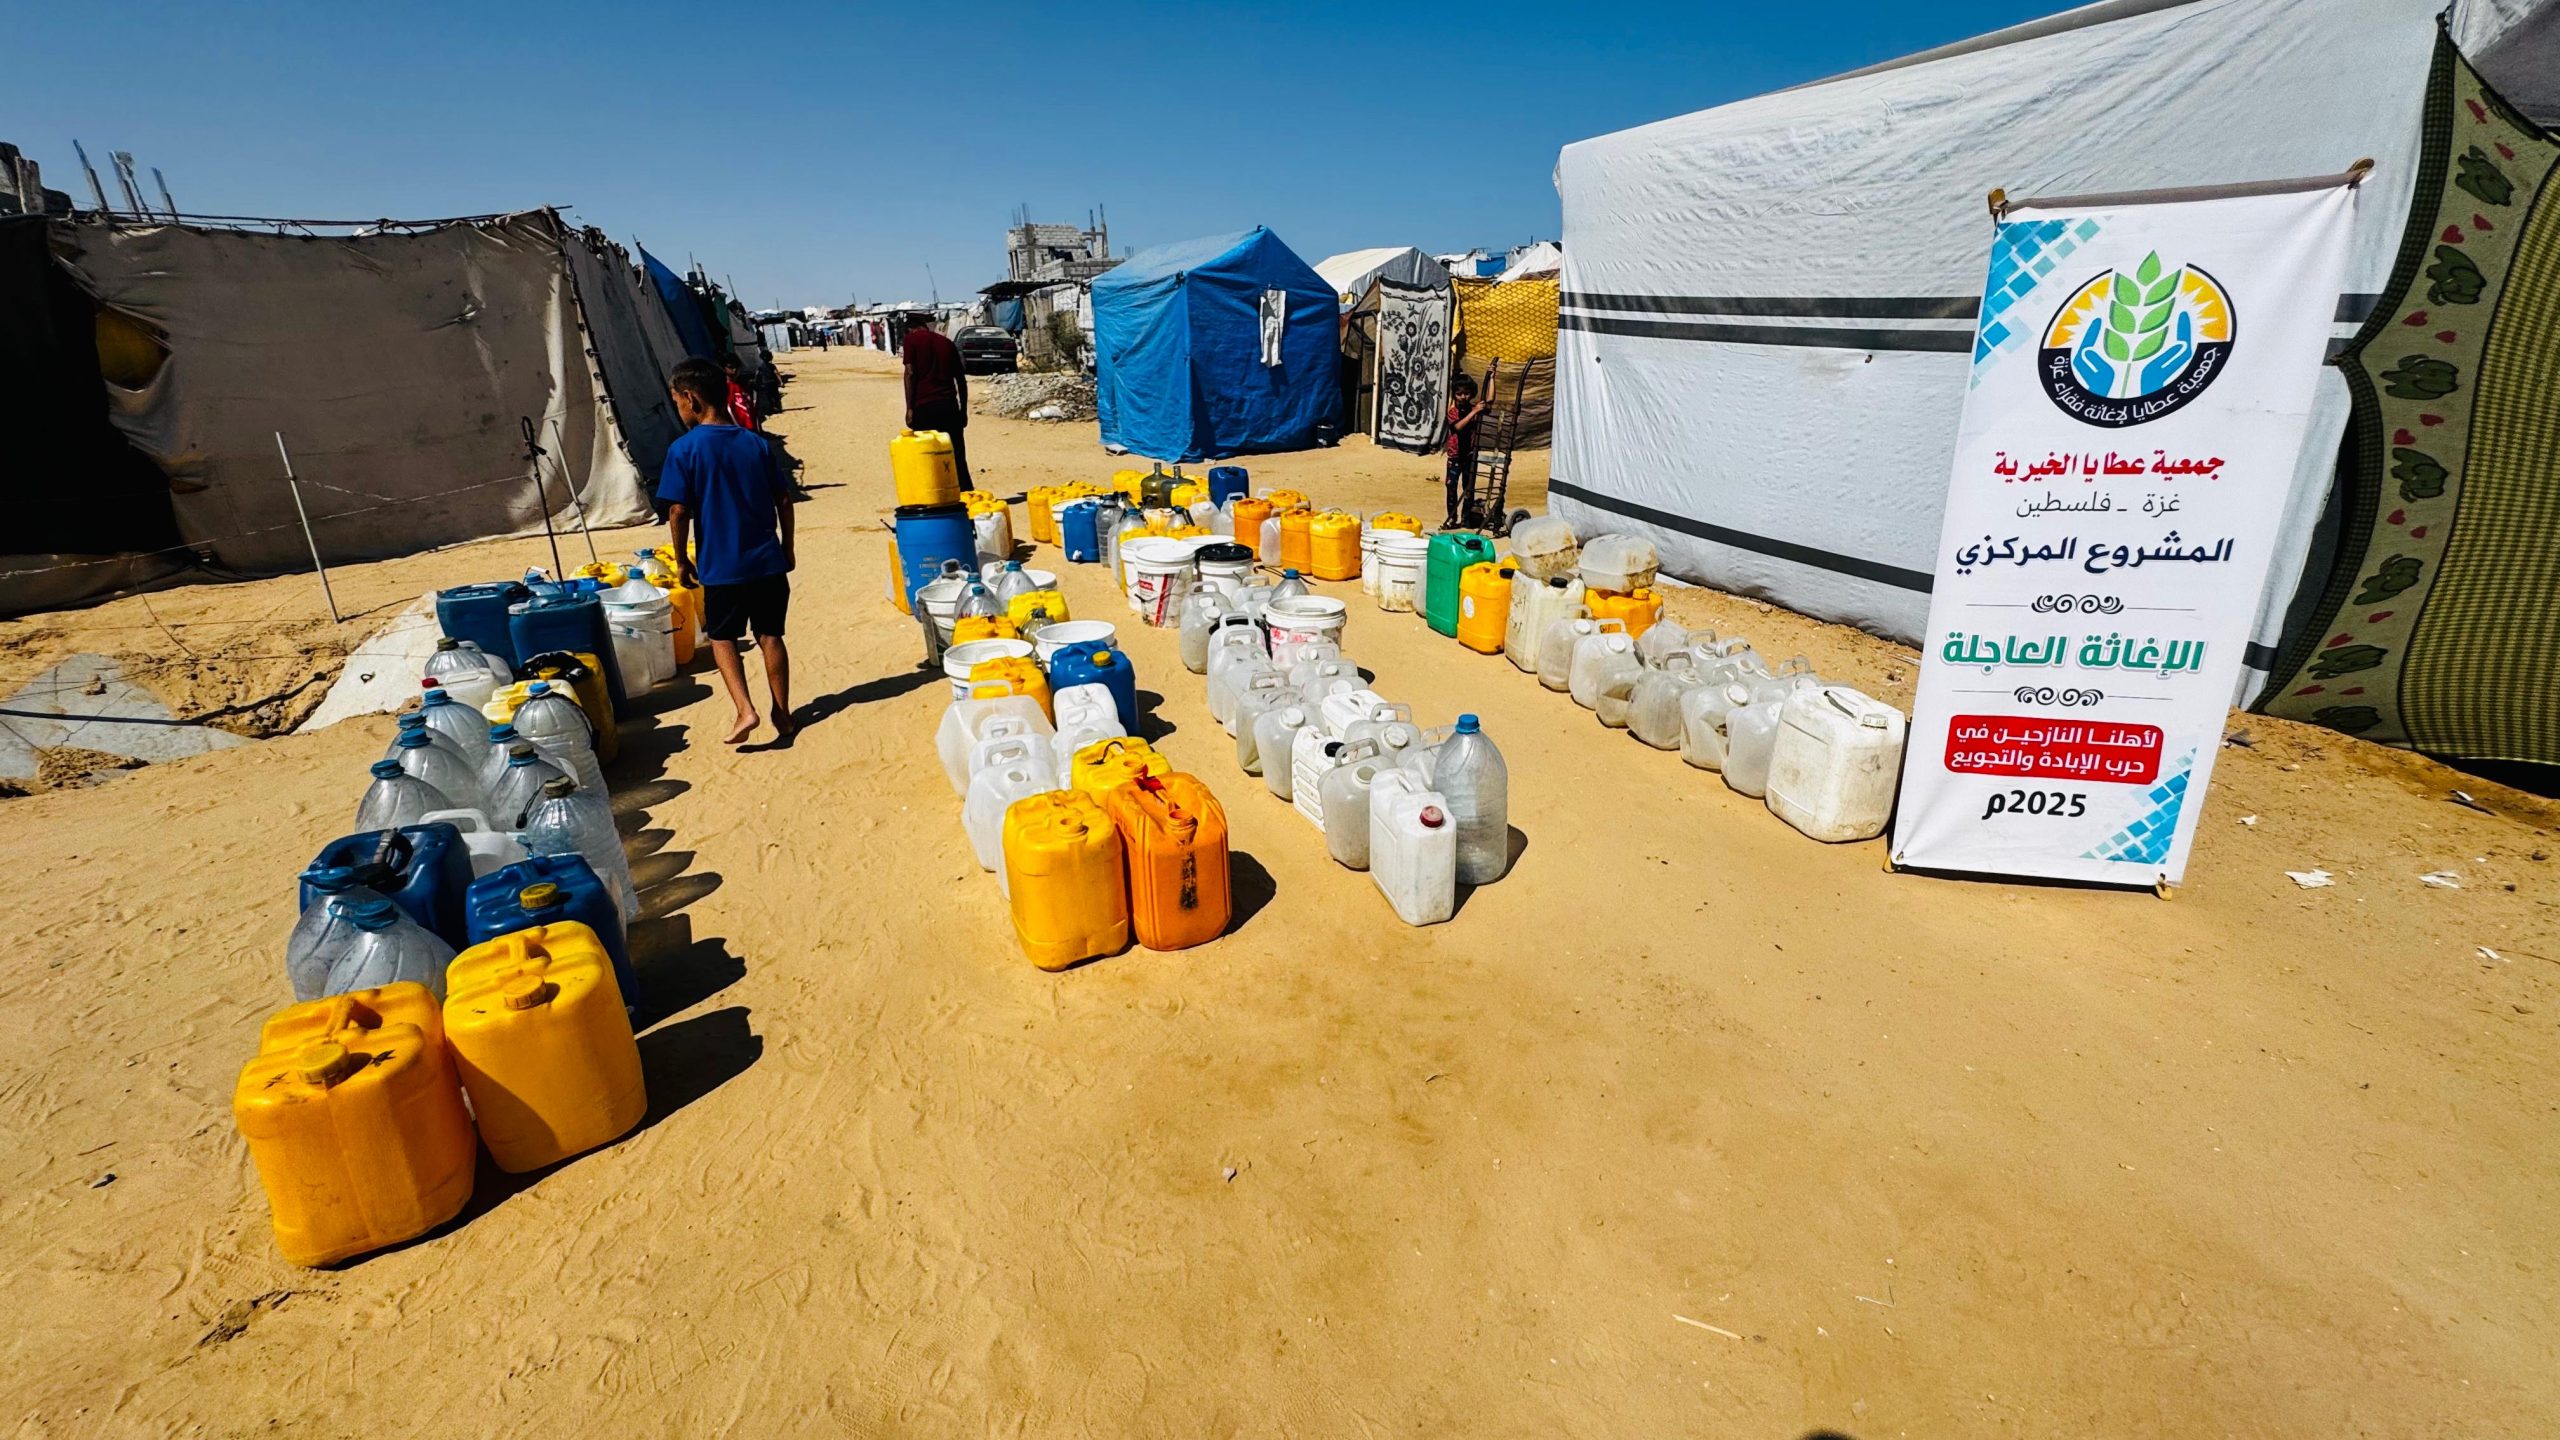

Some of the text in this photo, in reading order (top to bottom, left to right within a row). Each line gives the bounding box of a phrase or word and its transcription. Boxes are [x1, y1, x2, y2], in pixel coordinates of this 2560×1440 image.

[2049, 347, 2221, 425] جمعية عطايا لإغاثة فقراء غزة
[1993, 449, 2226, 483] جمعية عطايا الخيرية
[2016, 490, 2112, 518] فلسطين
[2141, 492, 2182, 518] غزة
[1955, 530, 2235, 576] المشروع المركزي
[1941, 631, 2206, 677] الإغاثة العاجلة
[1956, 722, 2158, 749] لأهلنا النازحين في
[1951, 748, 2145, 778] حرب الإبادة والتجويع
